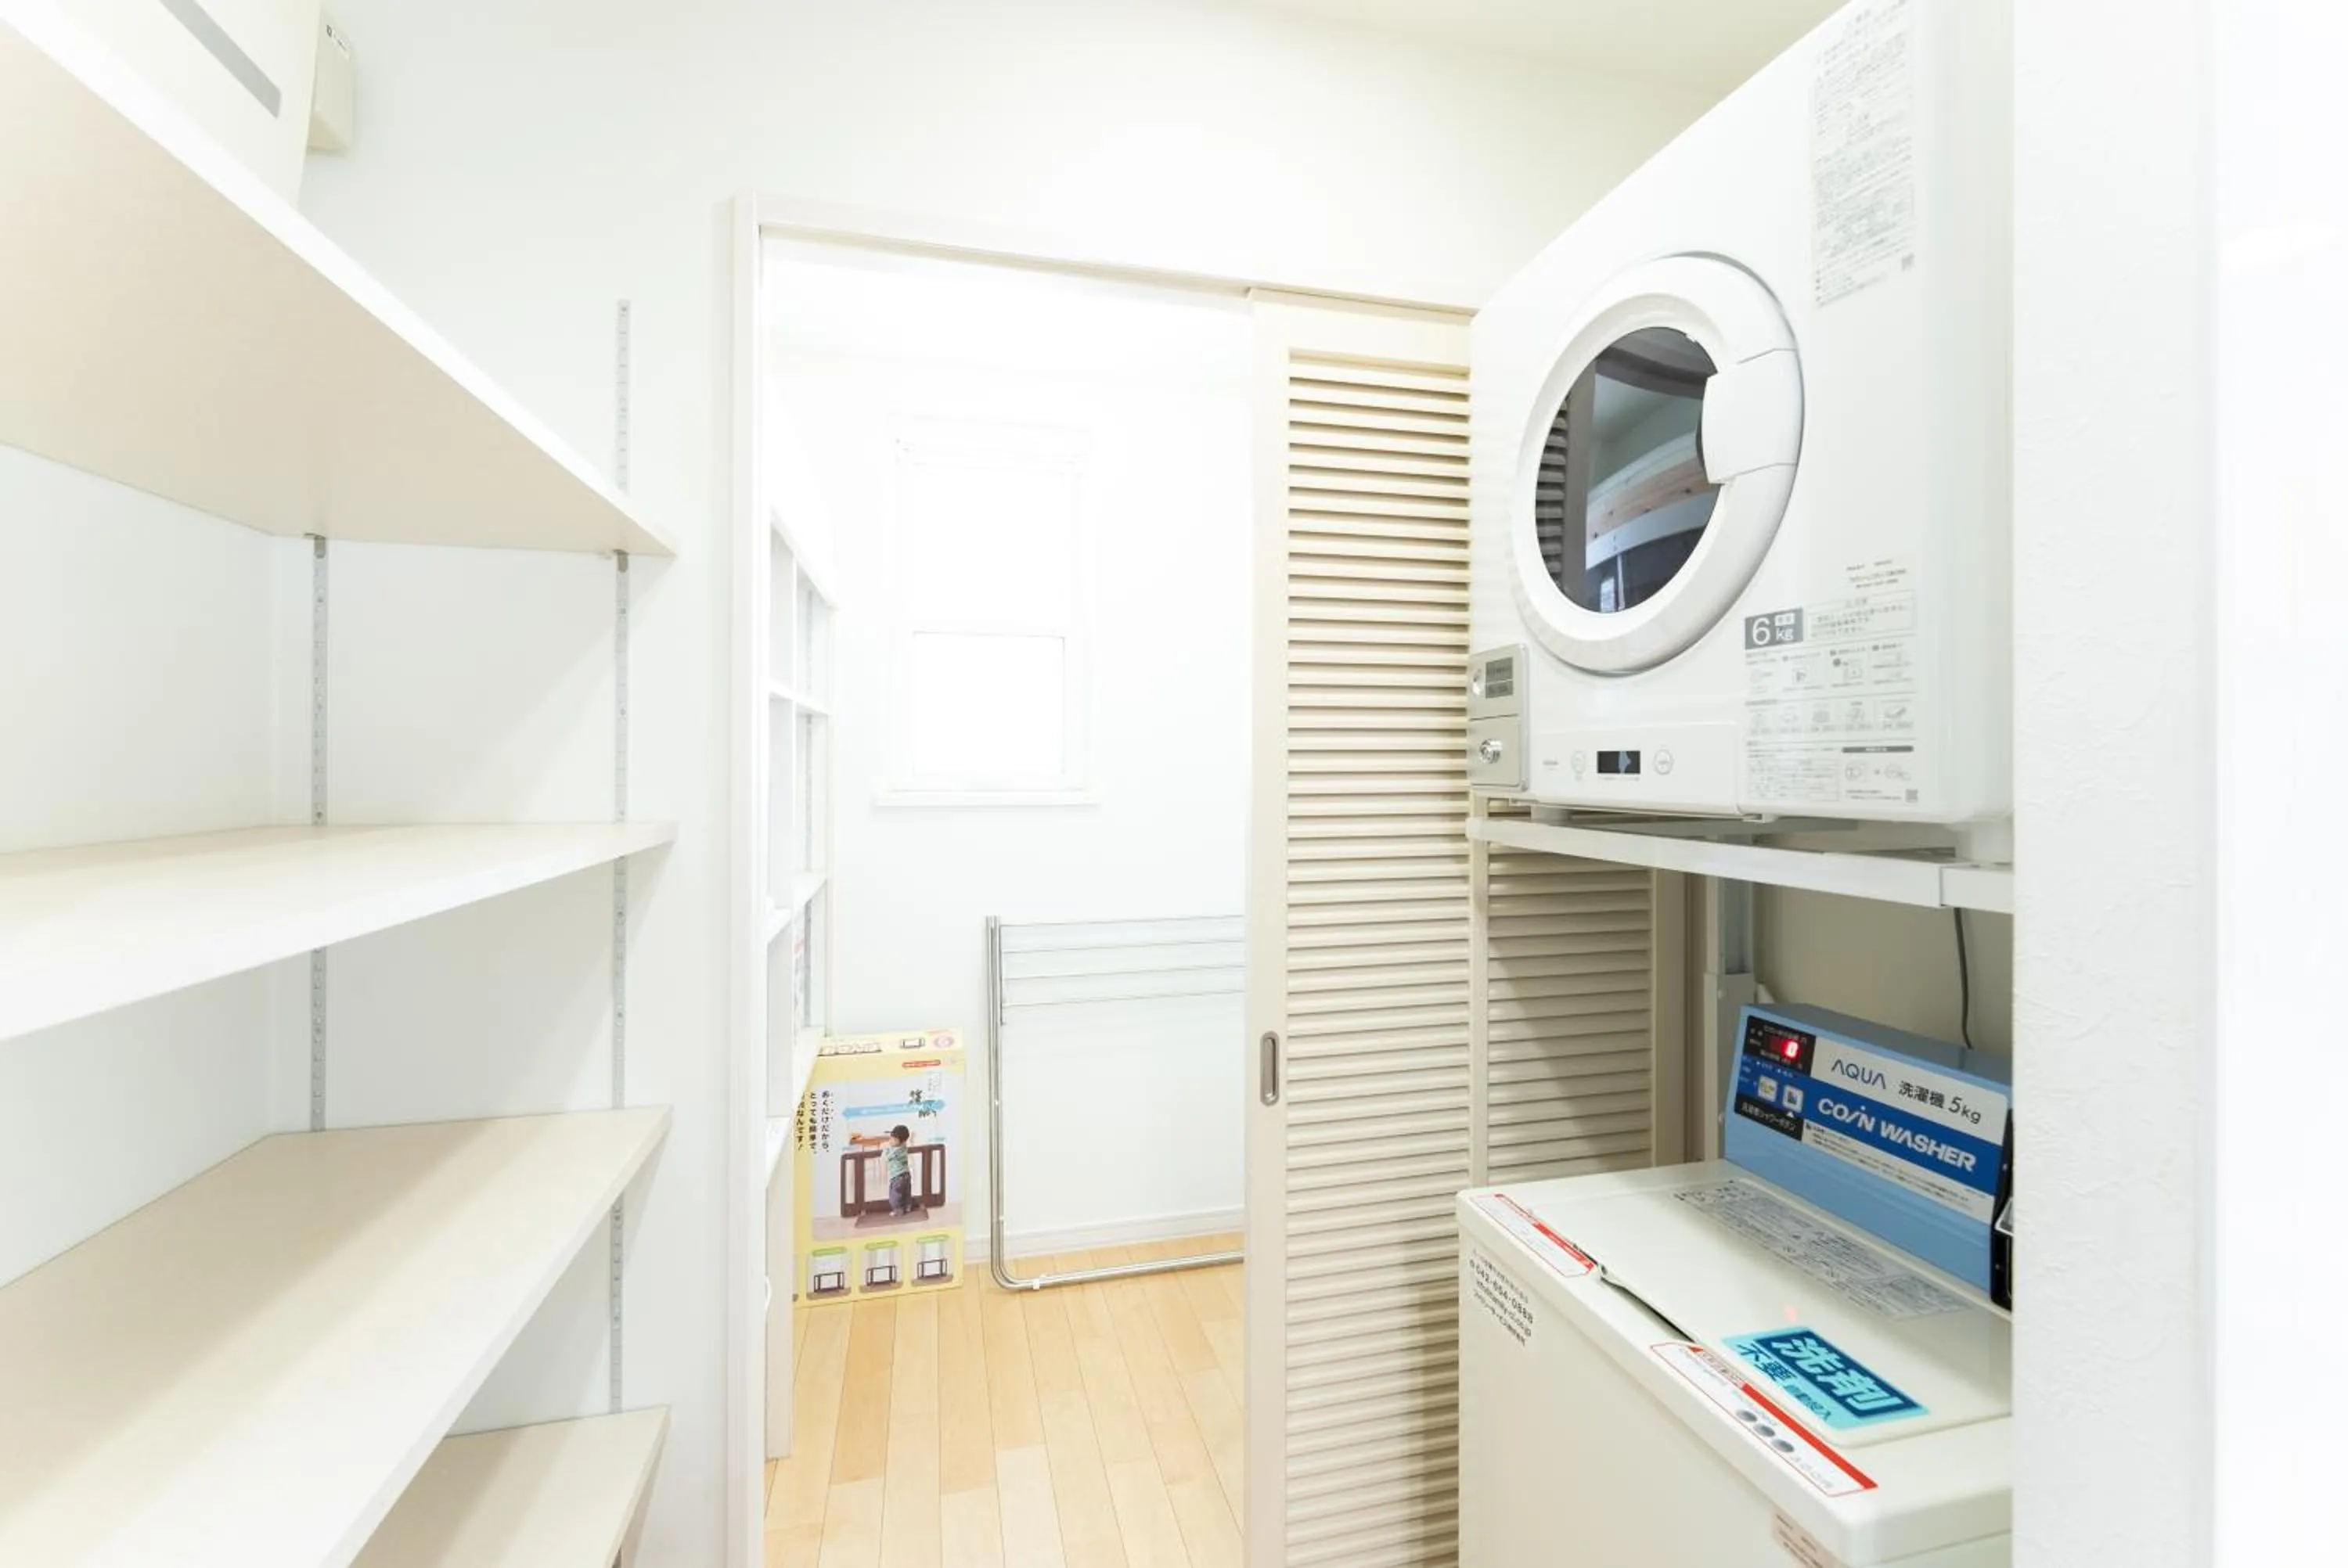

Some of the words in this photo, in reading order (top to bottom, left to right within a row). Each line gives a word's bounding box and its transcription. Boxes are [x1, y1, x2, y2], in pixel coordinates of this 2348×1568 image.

[1752, 617, 1770, 646] 6
[1775, 627, 1795, 642] kg
[1786, 1041, 1799, 1059] 0
[1831, 1059, 1887, 1090] AQUA
[1950, 1097, 1982, 1125] 5kg
[1880, 1119, 1978, 1173] WASHER
[1770, 1336, 1904, 1411] 洗剤
